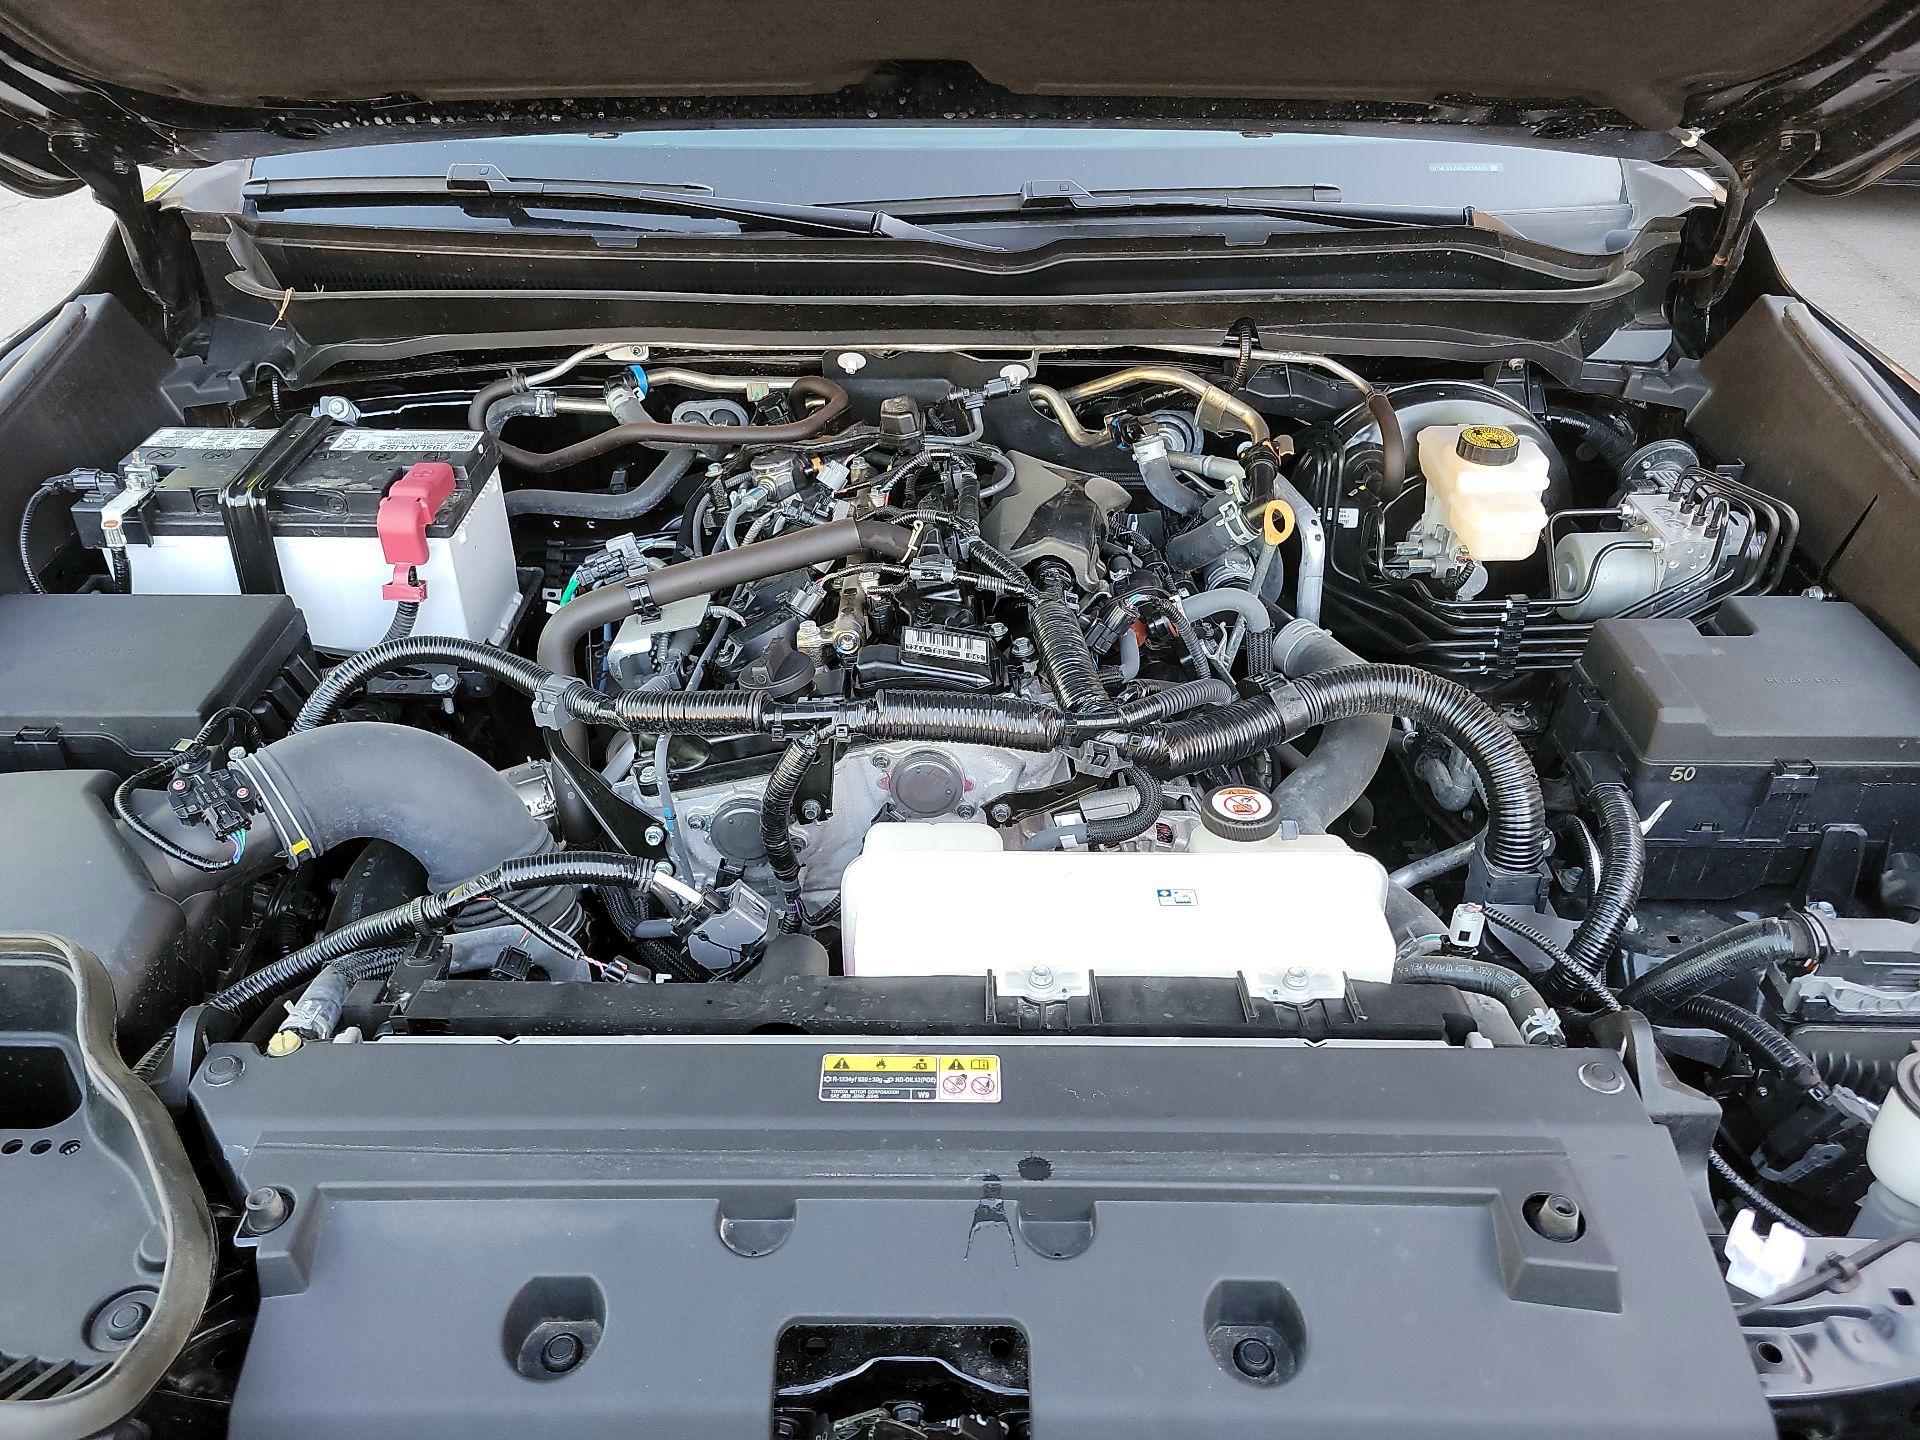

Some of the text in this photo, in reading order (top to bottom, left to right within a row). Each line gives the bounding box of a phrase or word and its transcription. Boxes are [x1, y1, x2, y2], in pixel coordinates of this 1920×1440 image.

[1669, 766, 1697, 782] 50
[832, 1075, 858, 1083] R-1234yf
[917, 1091, 931, 1099] W9
